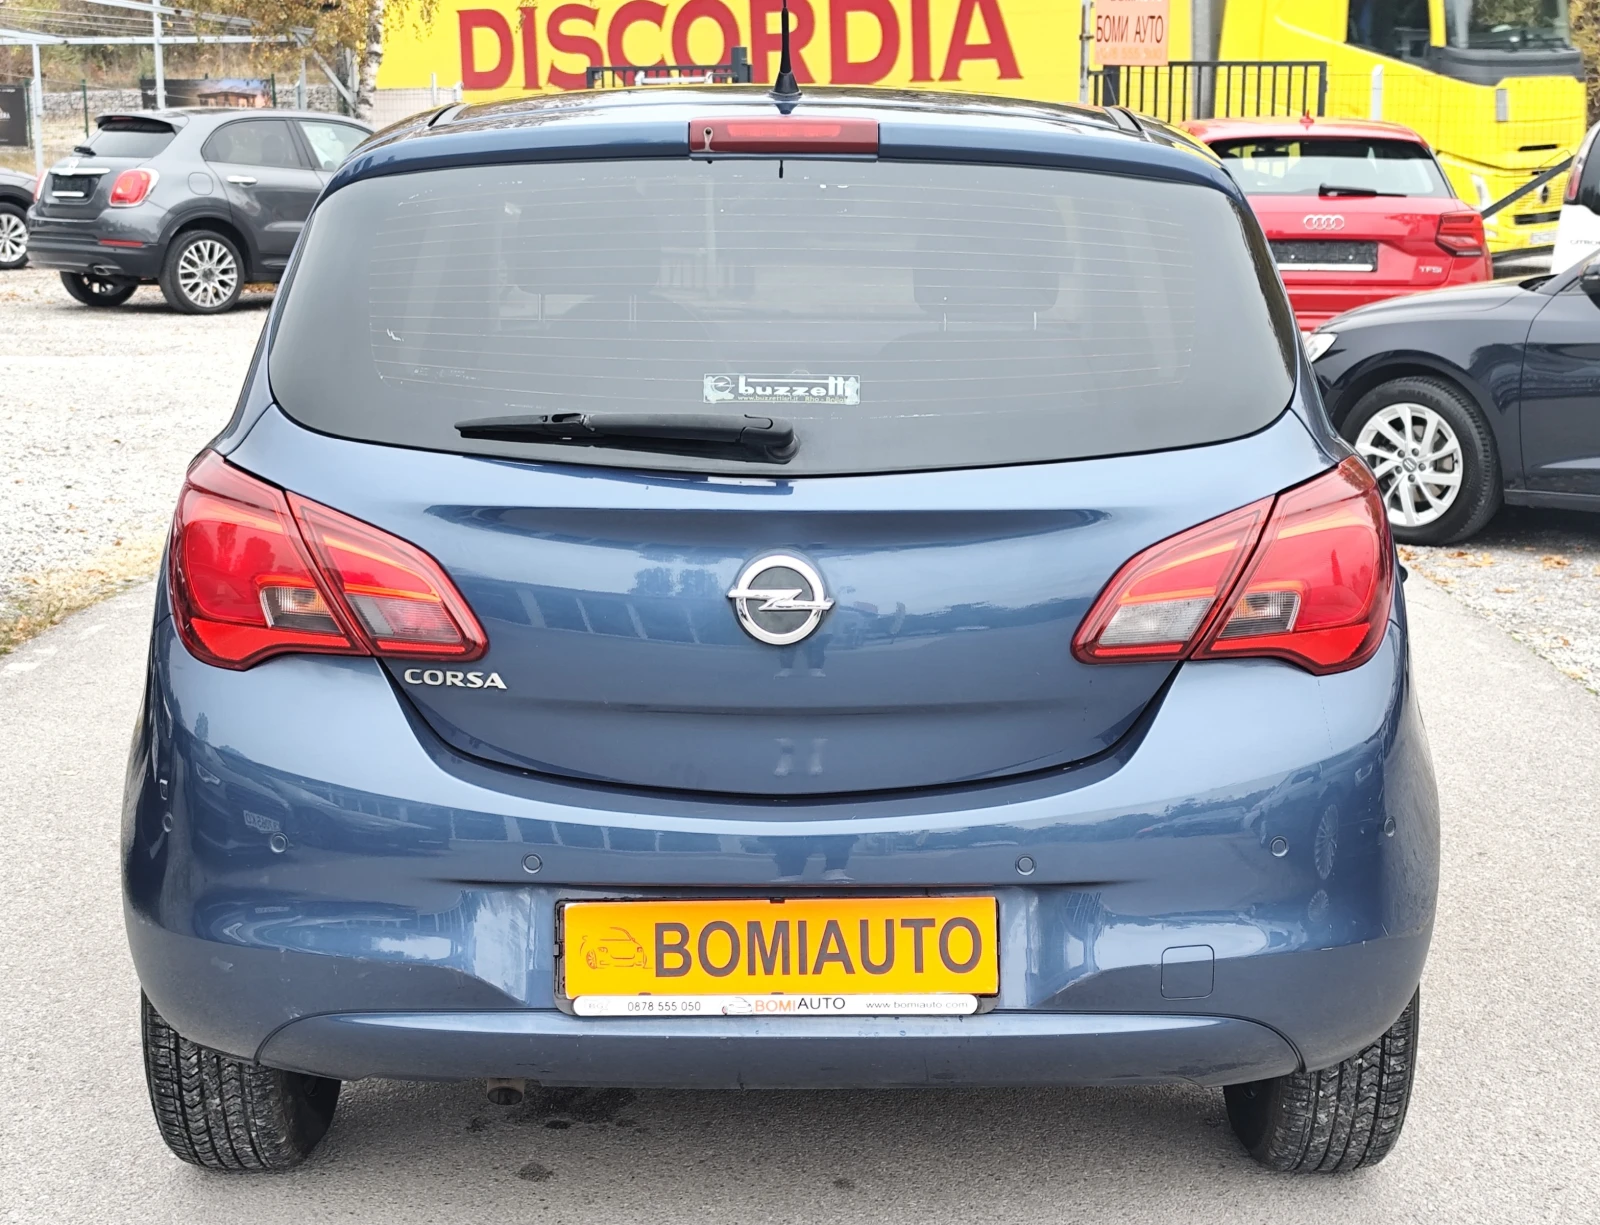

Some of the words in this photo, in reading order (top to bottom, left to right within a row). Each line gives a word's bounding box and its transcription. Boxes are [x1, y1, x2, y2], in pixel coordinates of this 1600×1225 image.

[1096, 15, 1128, 42] БОМИ
[1134, 15, 1164, 43] АУТО
[457, 0, 1022, 90] DISCORDIA
[1418, 265, 1442, 273] TFSI
[404, 668, 508, 690] CORSA
[655, 916, 982, 978] BOMIAUTO
[628, 1002, 654, 1011] 0878
[658, 1001, 677, 1011] 555
[681, 1001, 701, 1011] 050
